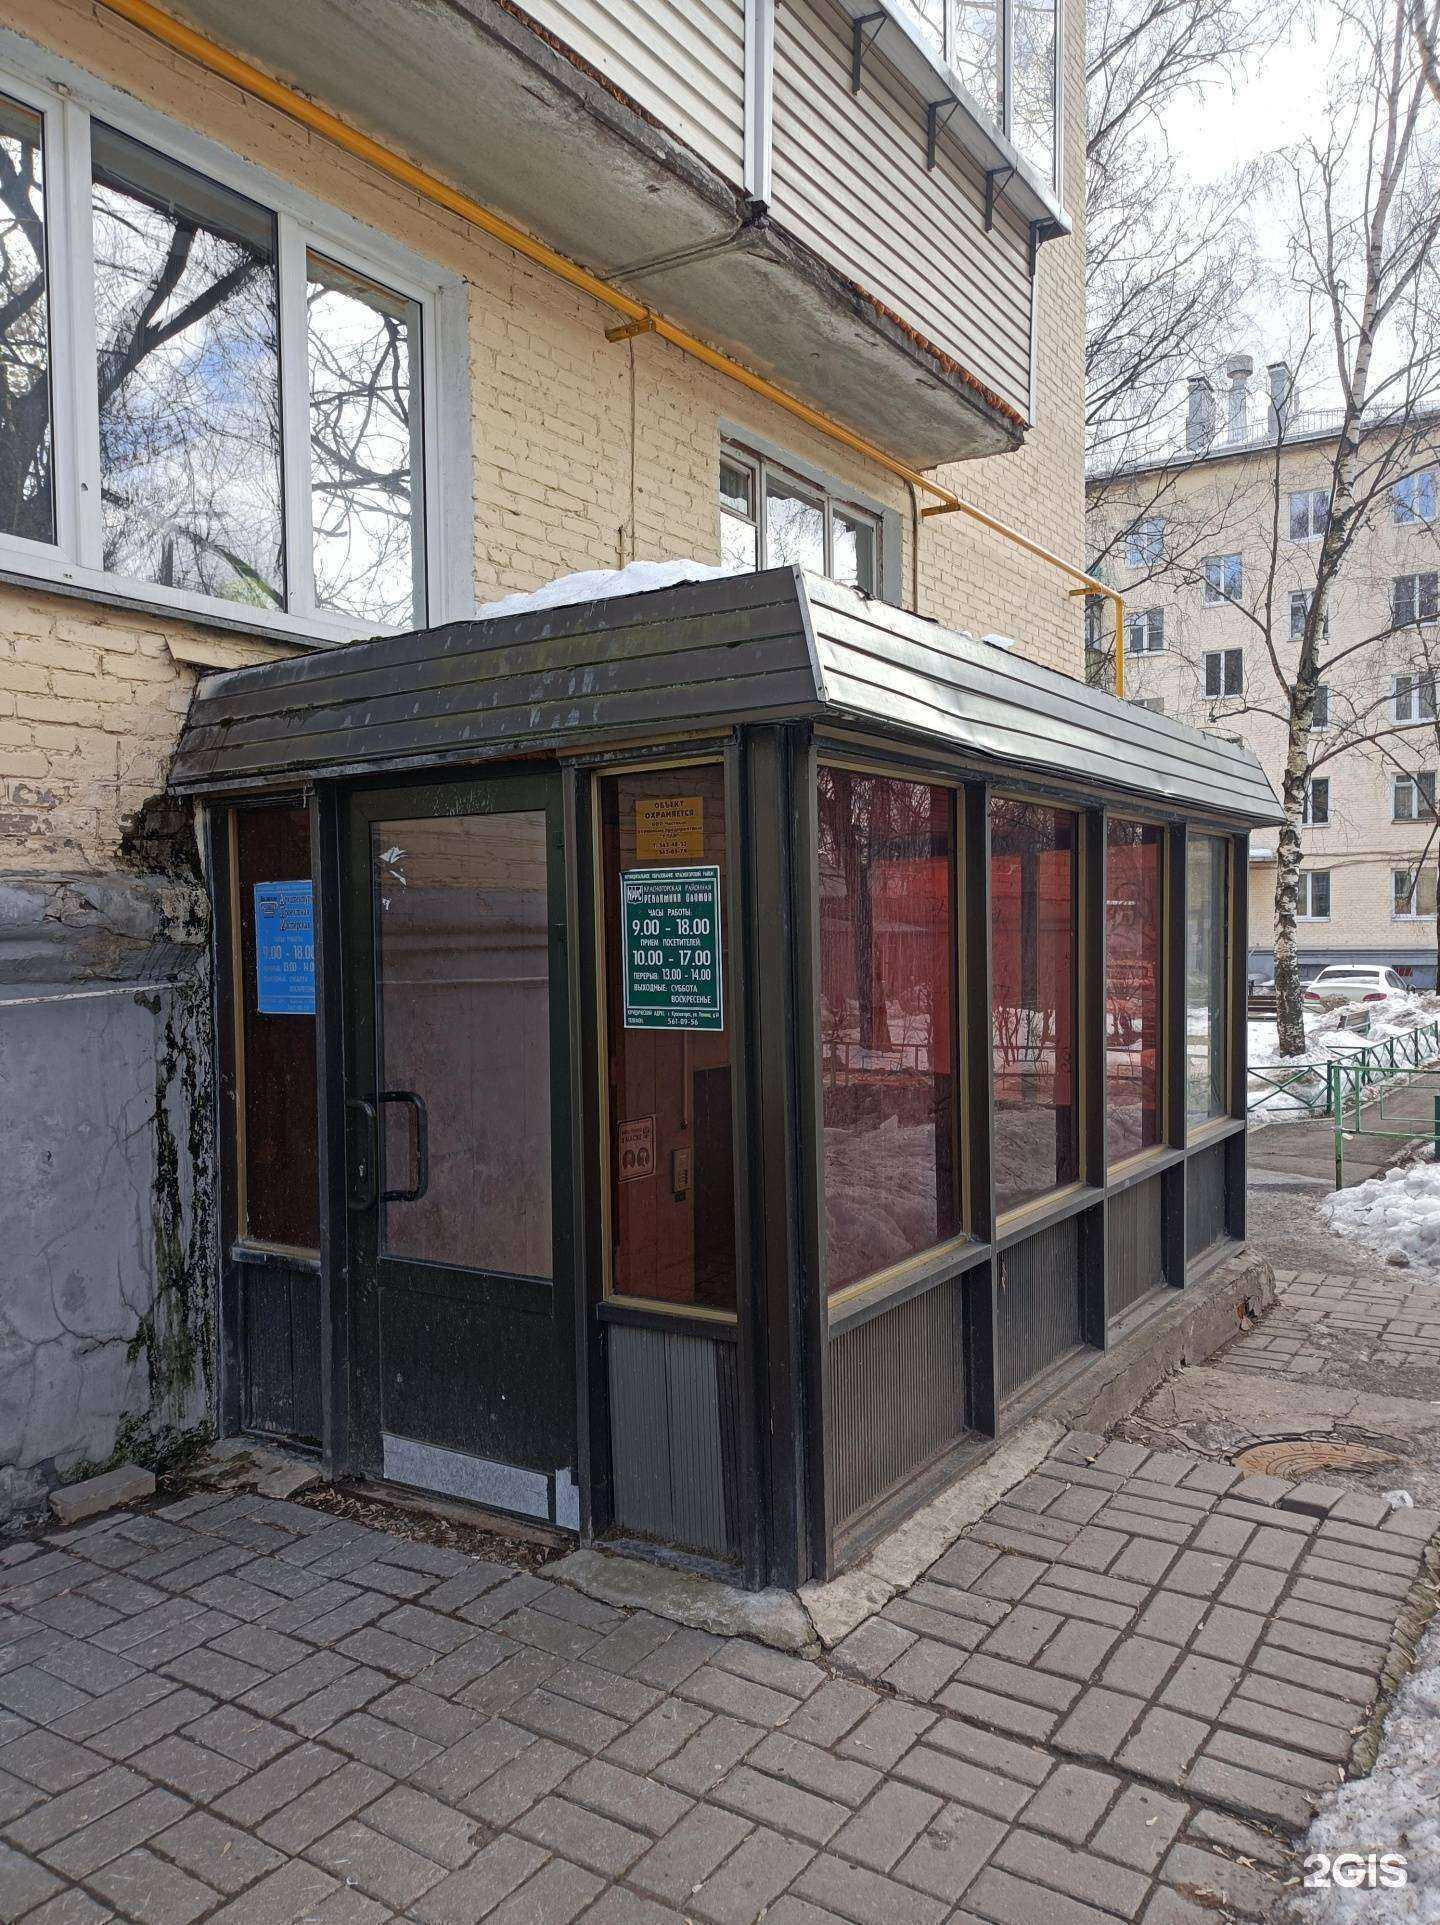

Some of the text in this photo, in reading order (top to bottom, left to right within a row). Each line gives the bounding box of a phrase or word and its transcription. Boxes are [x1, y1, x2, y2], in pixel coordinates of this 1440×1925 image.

[645, 809, 694, 819] ОХРАНЯЕТСЯ
[648, 909, 664, 917] ЧАСЫ
[632, 919, 660, 936] 9.00
[676, 918, 710, 935] 18.00
[632, 950, 663, 966] 10.00
[679, 949, 711, 966] 17.00
[661, 968, 682, 981] 13.00
[690, 968, 711, 981] 14.00
[670, 984, 698, 992] СУББОТА
[670, 995, 712, 1004] ВОСКРЕСЕНЬЕ
